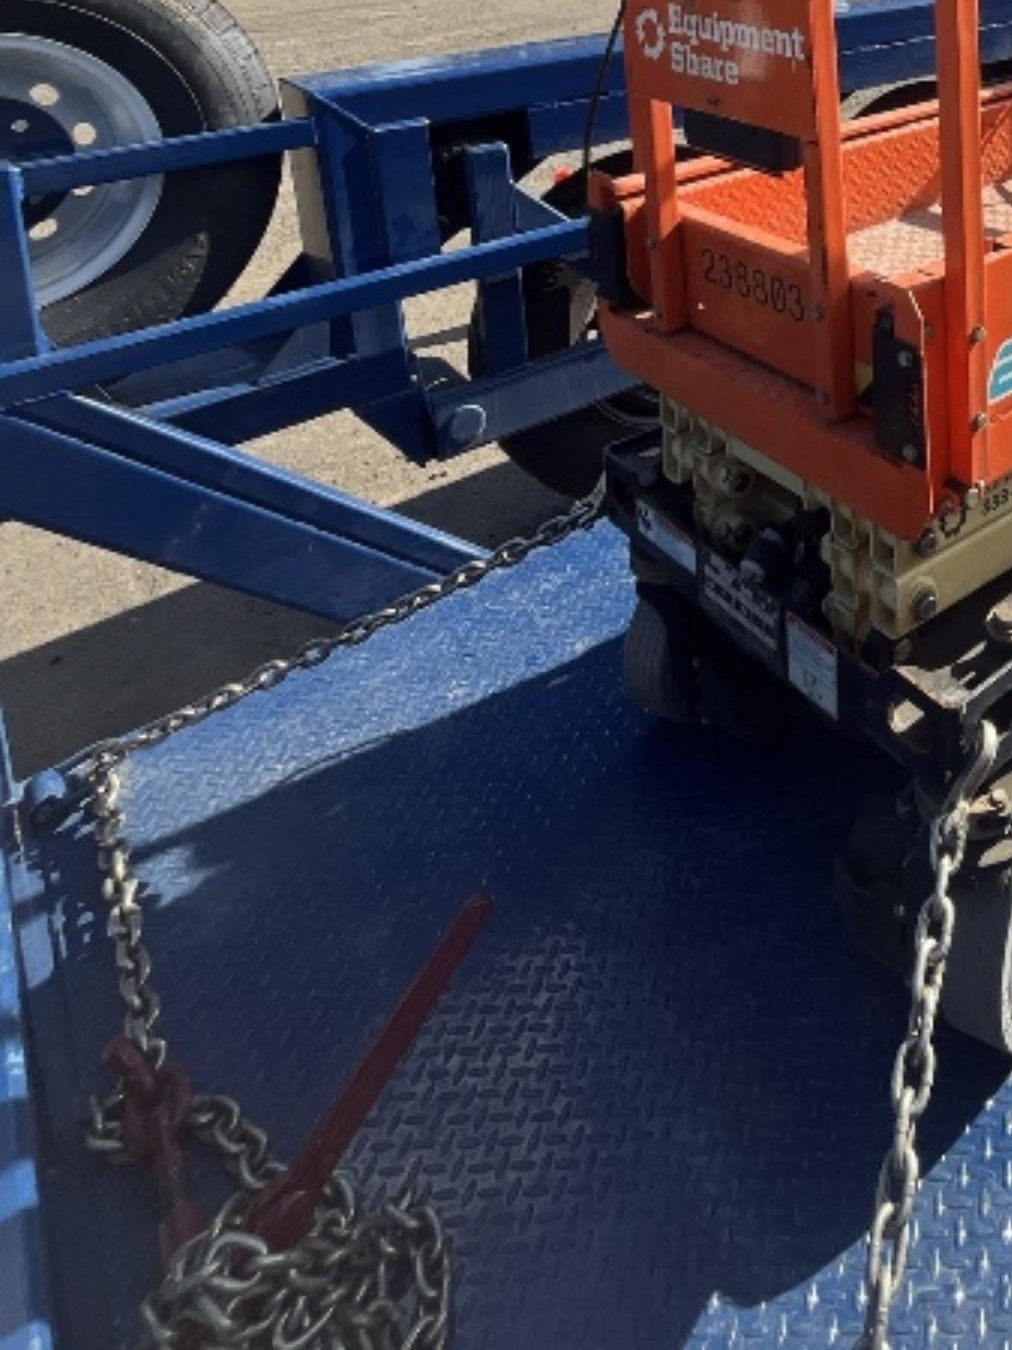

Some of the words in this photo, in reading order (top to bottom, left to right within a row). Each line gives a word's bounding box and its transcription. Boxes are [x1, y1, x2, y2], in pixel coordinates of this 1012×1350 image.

[667, 3, 805, 62] Equipment
[671, 41, 739, 86] Share
[701, 247, 805, 322] 238803
